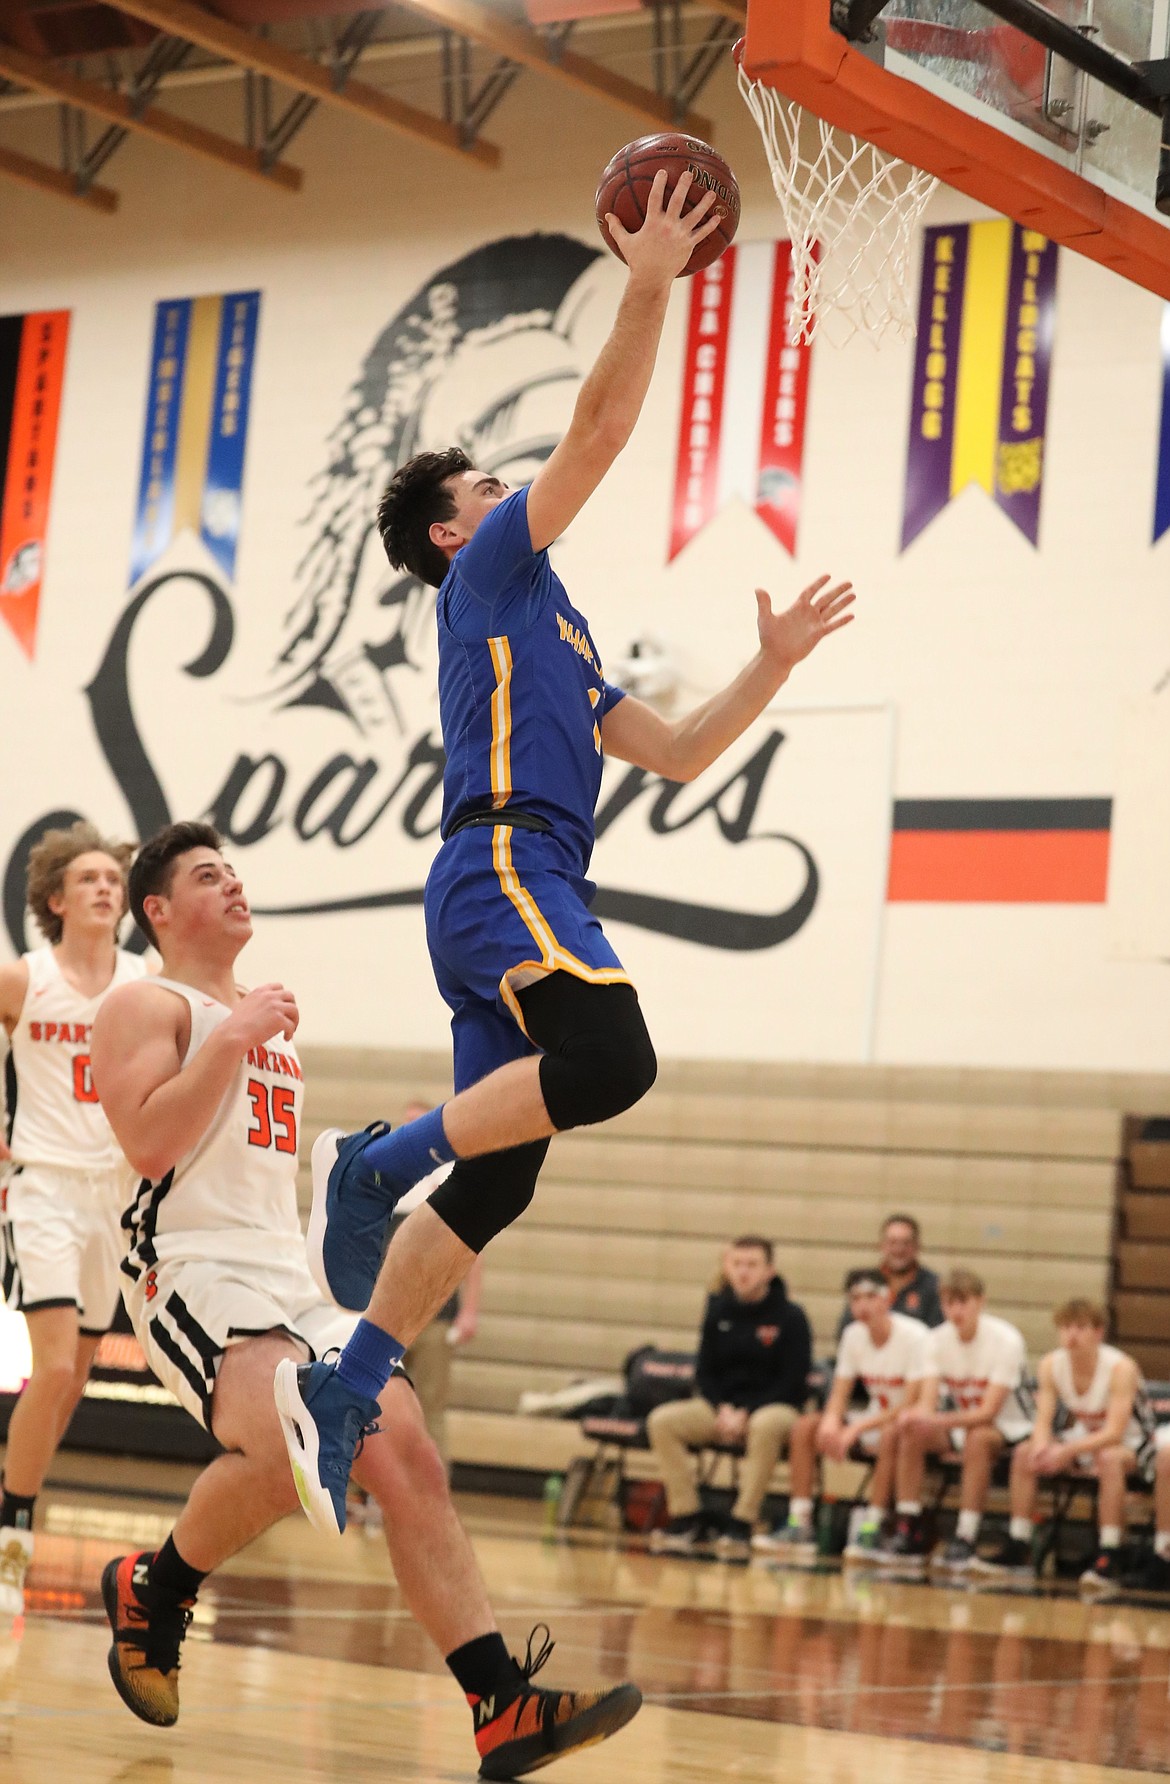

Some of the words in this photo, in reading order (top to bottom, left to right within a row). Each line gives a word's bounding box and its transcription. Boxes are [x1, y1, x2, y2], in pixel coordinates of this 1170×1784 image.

[921, 234, 955, 440] KELLOGG
[1011, 229, 1048, 433] WILDCATS
[4, 567, 819, 953] Sparns
[247, 1077, 297, 1156] 35
